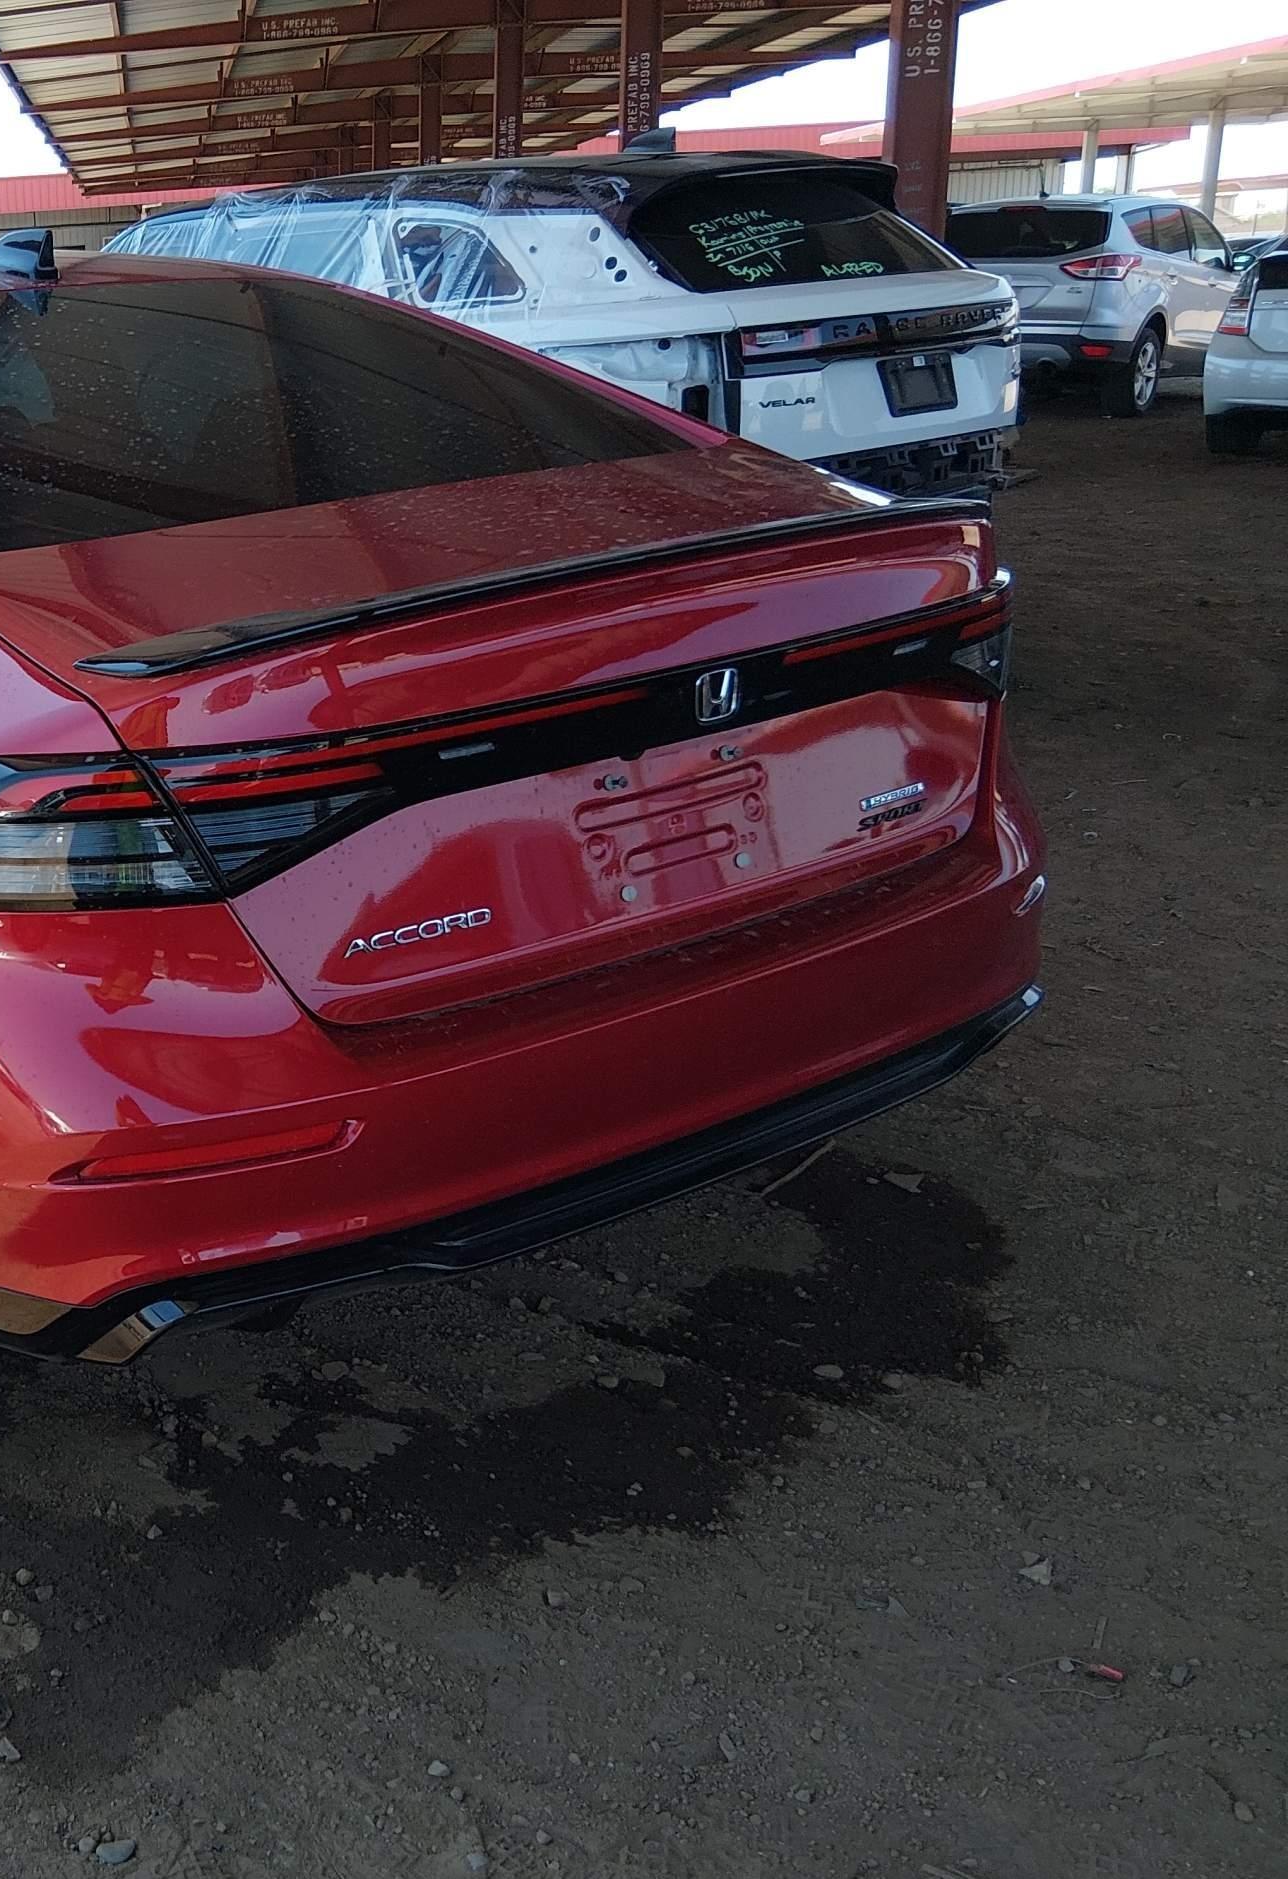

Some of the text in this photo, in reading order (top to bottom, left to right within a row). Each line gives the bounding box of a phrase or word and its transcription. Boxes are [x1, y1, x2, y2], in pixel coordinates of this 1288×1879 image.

[283, 18, 318, 29] PREFAB
[904, 0, 924, 77] U.S. PR
[627, 83, 639, 132] PREFAB
[832, 316, 928, 340] RAGE
[759, 396, 816, 409] VELAR
[872, 784, 920, 804] HYBRID
[856, 798, 928, 832] SPORT
[343, 908, 492, 959] ACCORD
